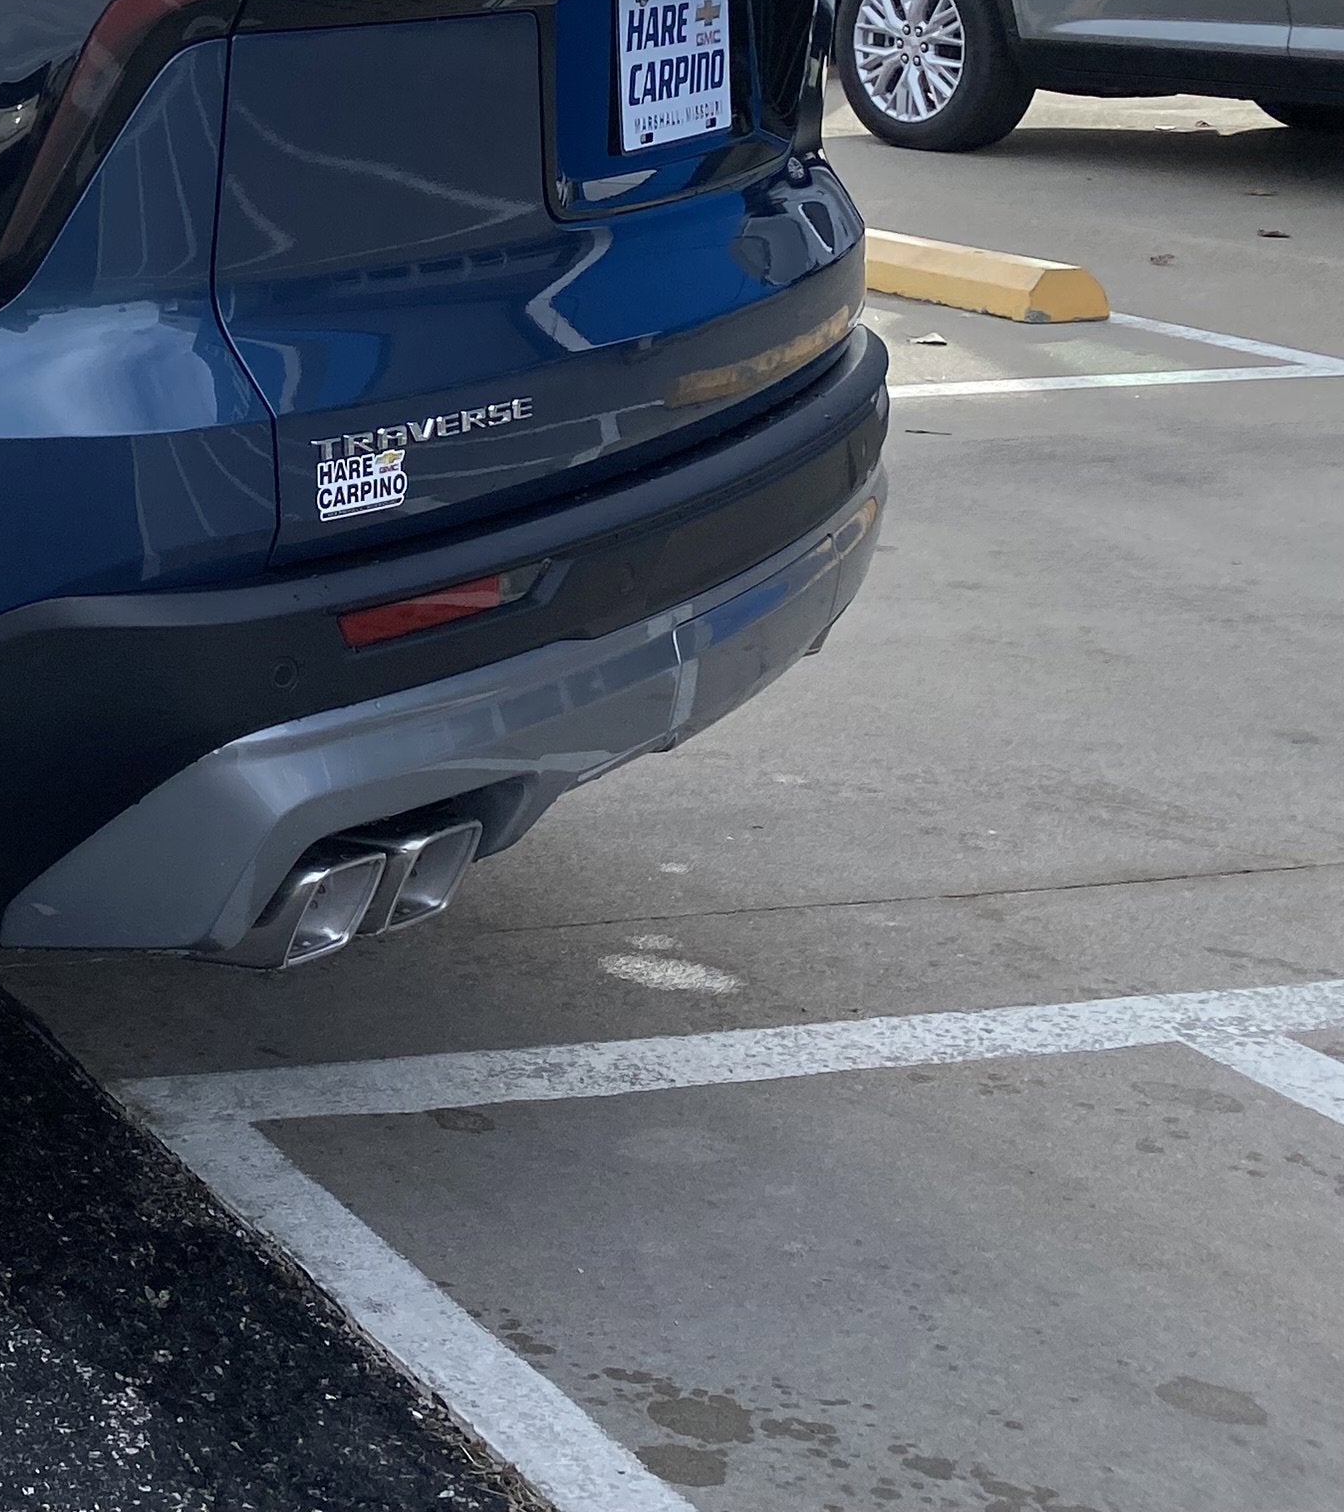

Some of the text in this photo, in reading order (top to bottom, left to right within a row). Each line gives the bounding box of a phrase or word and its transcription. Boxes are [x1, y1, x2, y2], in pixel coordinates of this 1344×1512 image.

[626, 2, 689, 52] HARE
[696, 29, 721, 46] GMC
[628, 49, 724, 106] CARPINO
[634, 110, 684, 134] MARSHALL,
[310, 396, 534, 460] TRAVERSE
[320, 456, 374, 486] HARE
[319, 473, 406, 510] CARPINO
